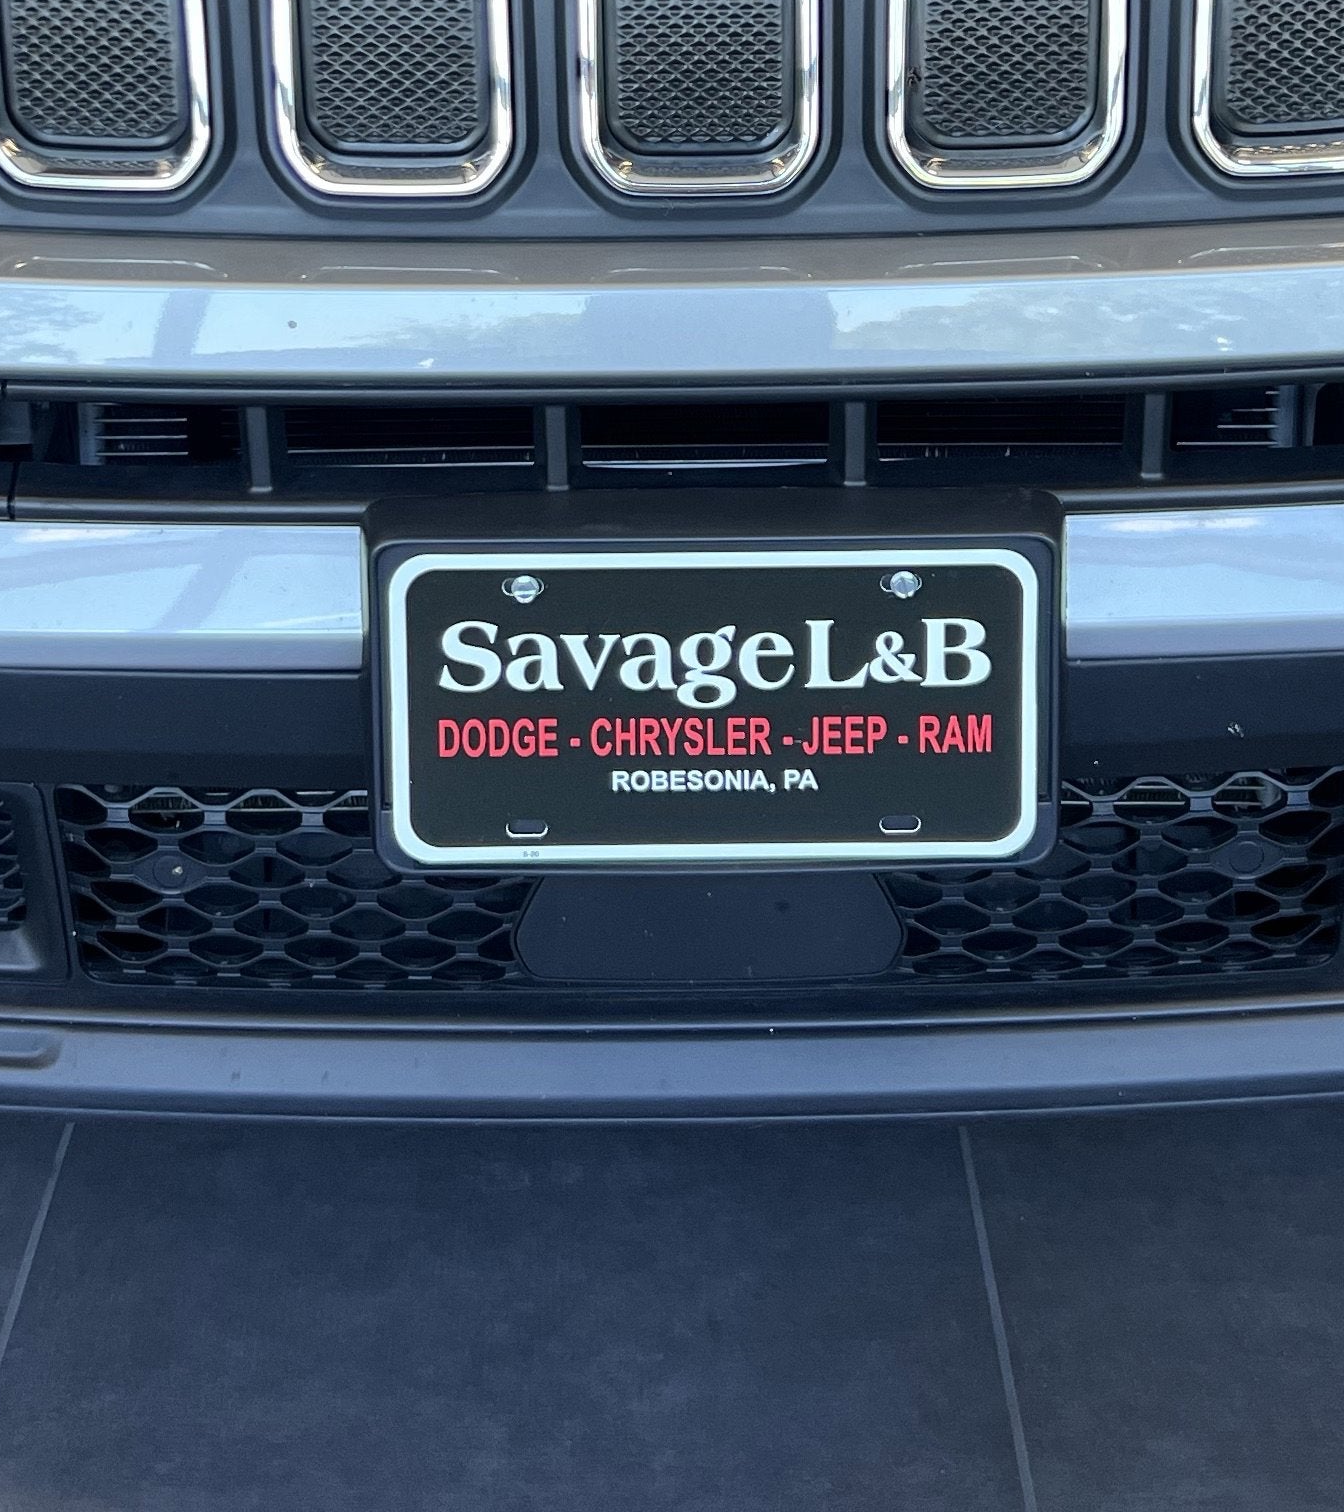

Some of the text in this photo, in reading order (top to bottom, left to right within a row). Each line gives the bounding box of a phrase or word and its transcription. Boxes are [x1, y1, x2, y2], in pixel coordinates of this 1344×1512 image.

[437, 716, 560, 758] DODGE
[589, 715, 773, 757] CHRYSLER
[802, 714, 888, 756] JEEP
[918, 713, 993, 754] RAM
[611, 768, 819, 793] ROBESONIA, PA
